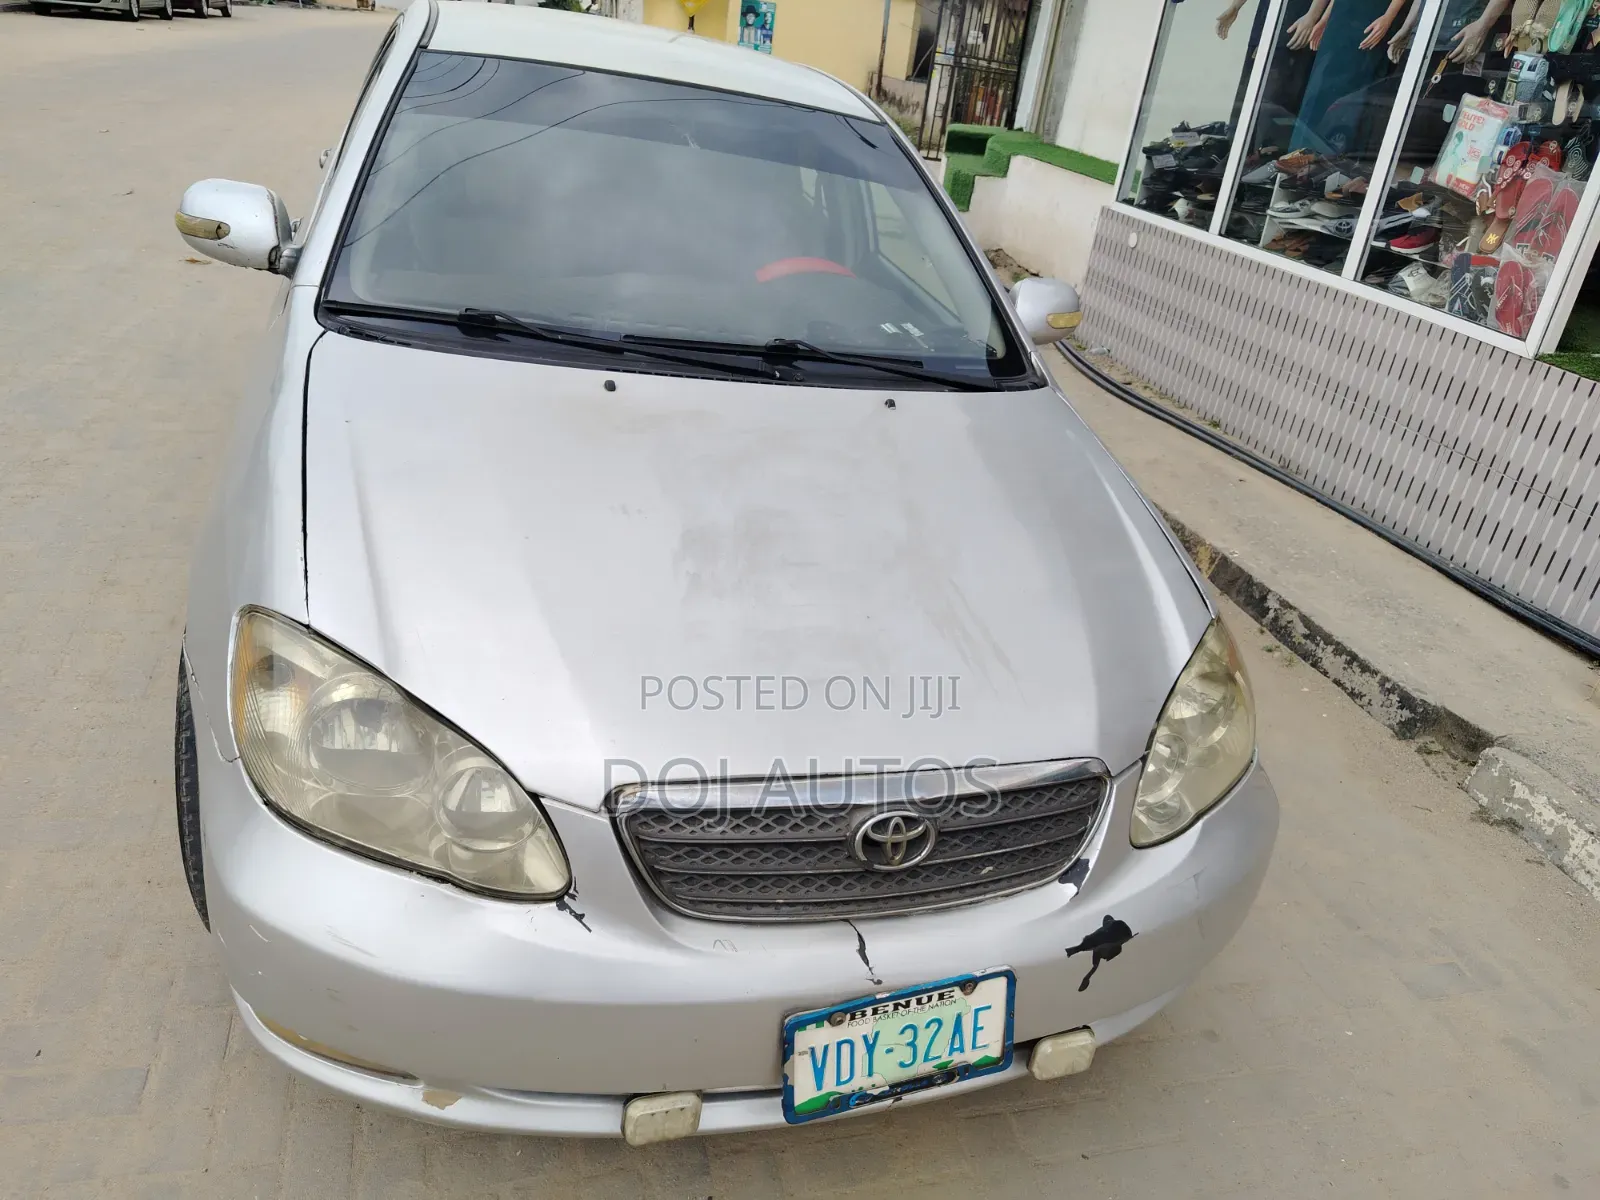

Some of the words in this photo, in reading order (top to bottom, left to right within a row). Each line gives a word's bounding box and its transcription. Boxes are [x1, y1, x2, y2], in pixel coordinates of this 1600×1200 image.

[847, 1017, 871, 1028] FOOD
[873, 1011, 899, 1023] BASKET
[900, 1008, 912, 1017] OF
[912, 1005, 925, 1014] THE
[928, 999, 956, 1010] NATION
[848, 990, 956, 1021] BENUE
[808, 1005, 992, 1092] VDY-32AE
